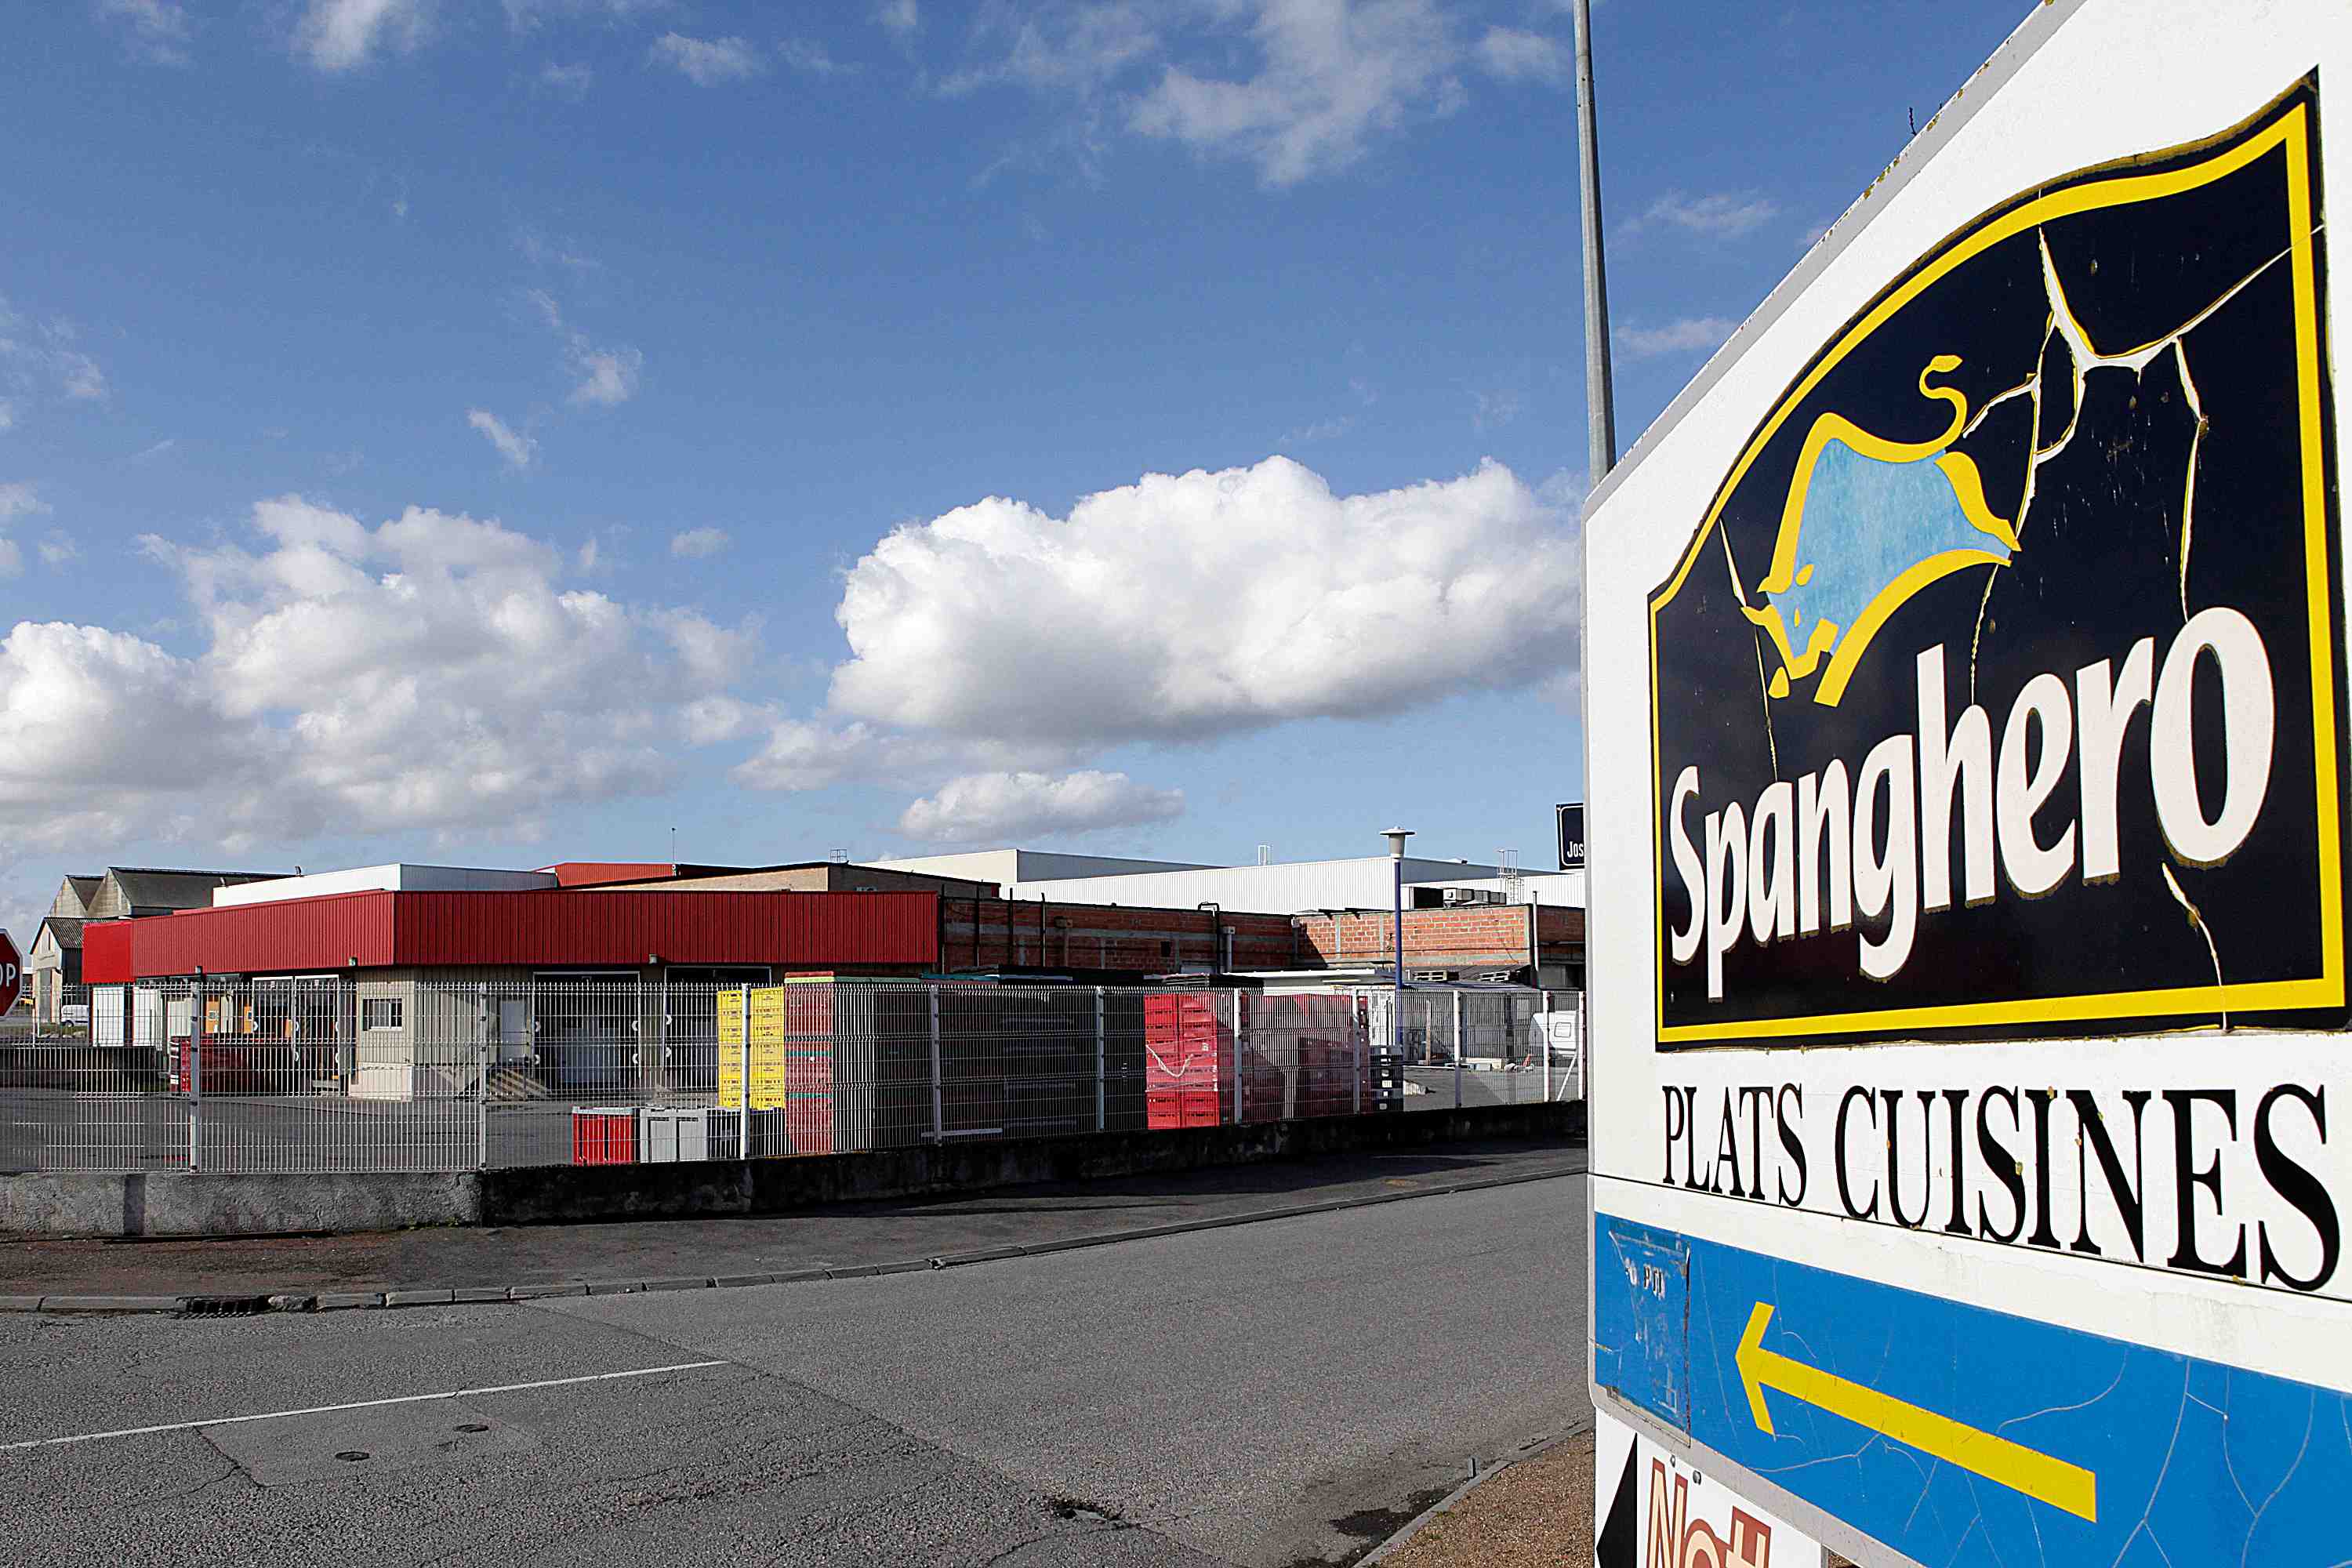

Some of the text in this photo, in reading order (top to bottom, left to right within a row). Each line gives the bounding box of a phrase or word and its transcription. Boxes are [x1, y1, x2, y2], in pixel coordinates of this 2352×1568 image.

[1670, 607, 2275, 1003] Spanghero
[1662, 1083, 2340, 1292] PLATS CUISINES
